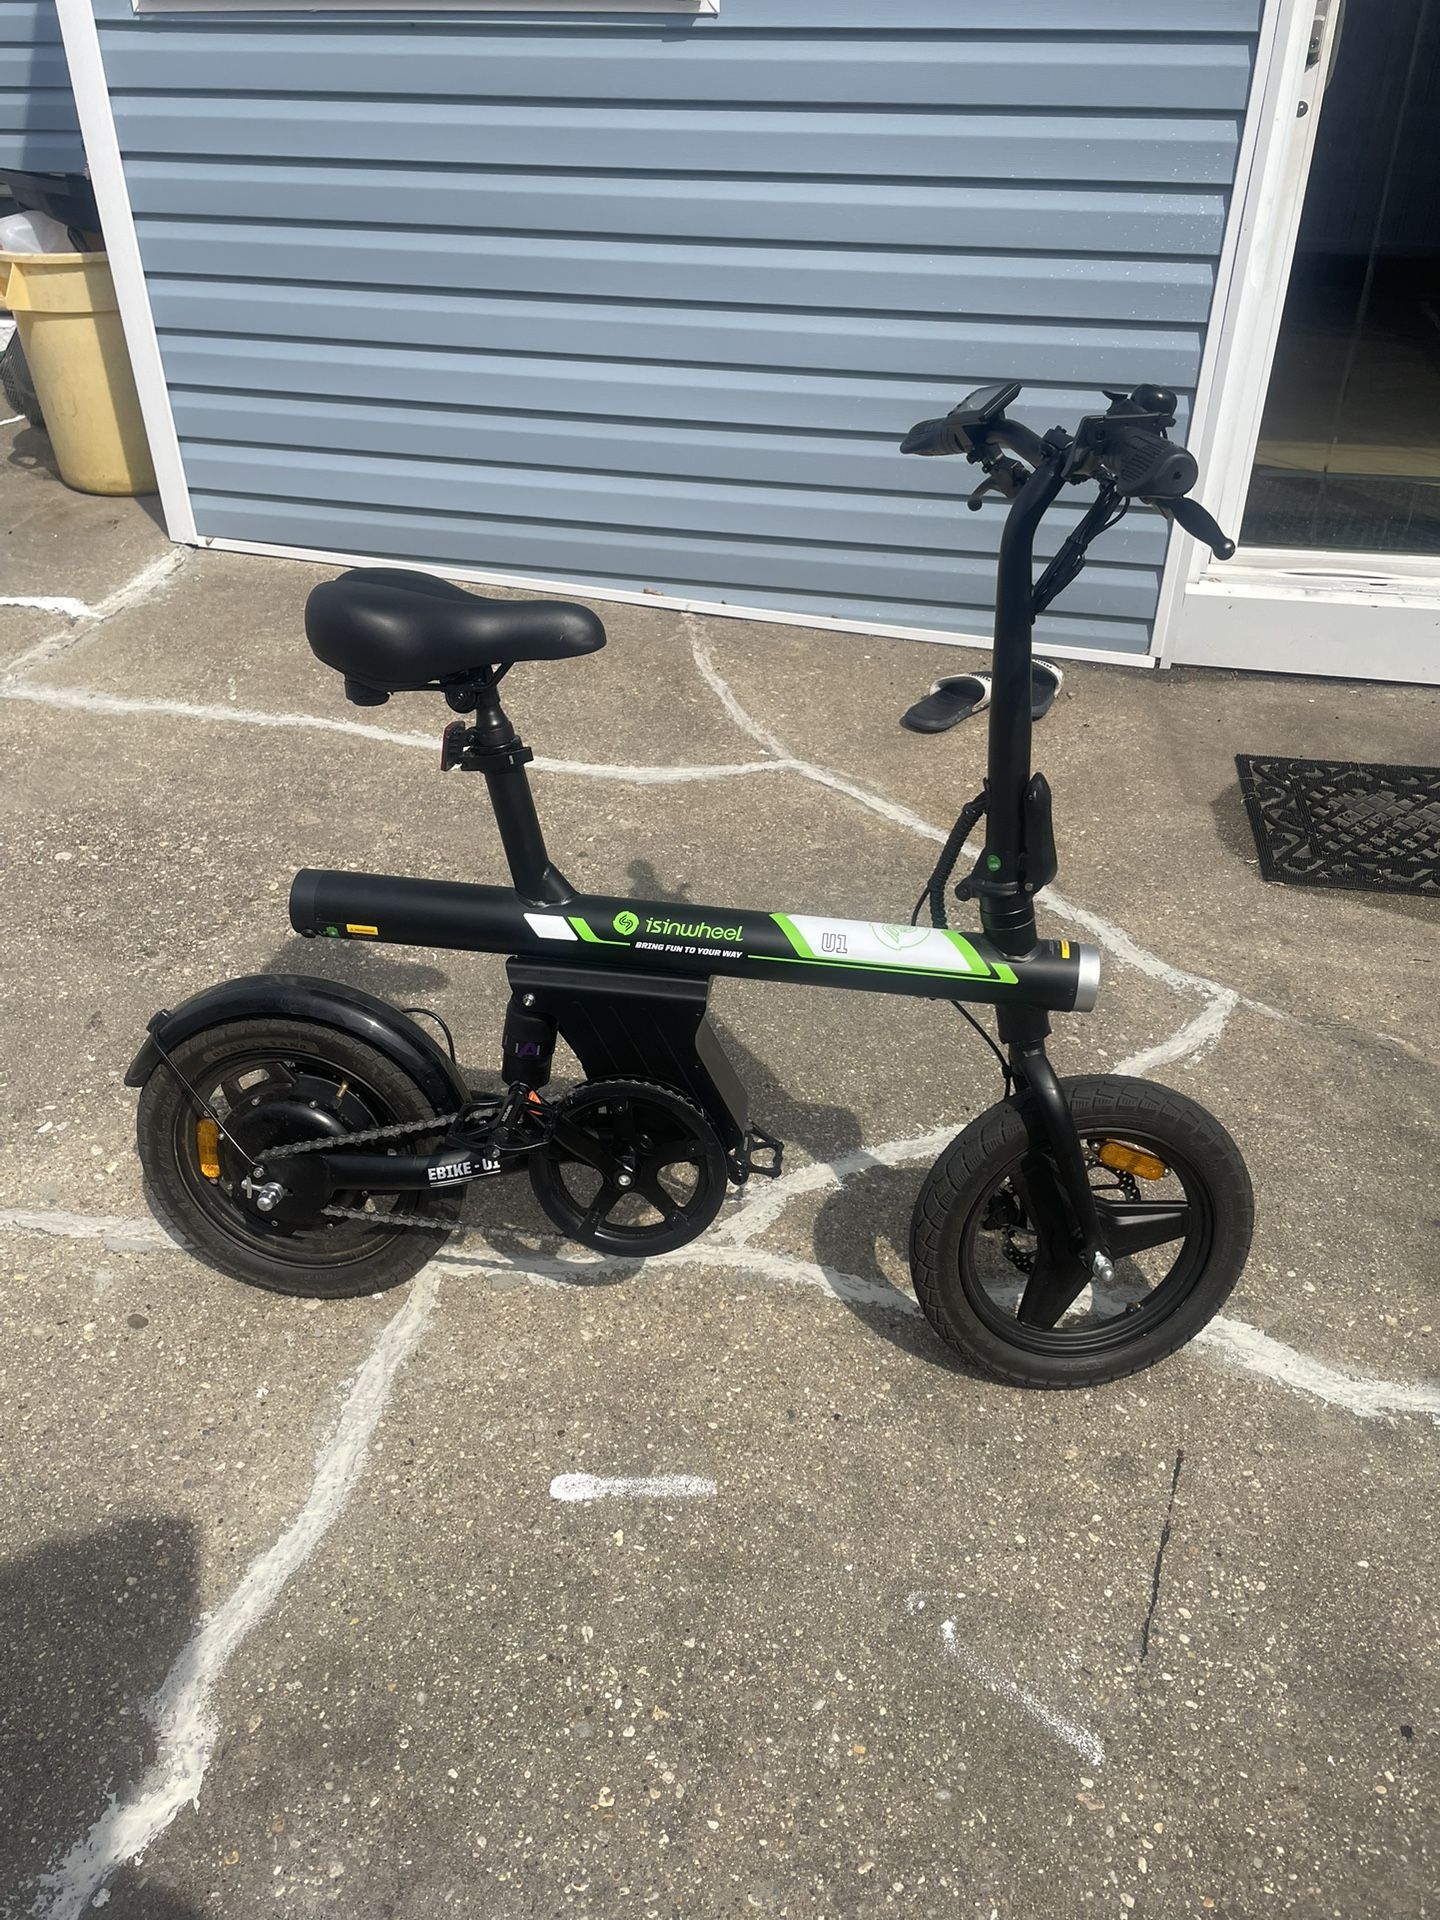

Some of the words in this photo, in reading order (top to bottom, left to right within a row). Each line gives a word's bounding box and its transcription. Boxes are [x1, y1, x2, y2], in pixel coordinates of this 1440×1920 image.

[646, 917, 744, 942] isinwheel
[635, 941, 665, 951] BRING
[665, 944, 683, 953] FUN
[684, 946, 696, 954] TO
[697, 947, 722, 957] YOUR
[722, 950, 743, 959] WAY
[821, 932, 848, 954] U1
[427, 1161, 472, 1181] EBIKE
